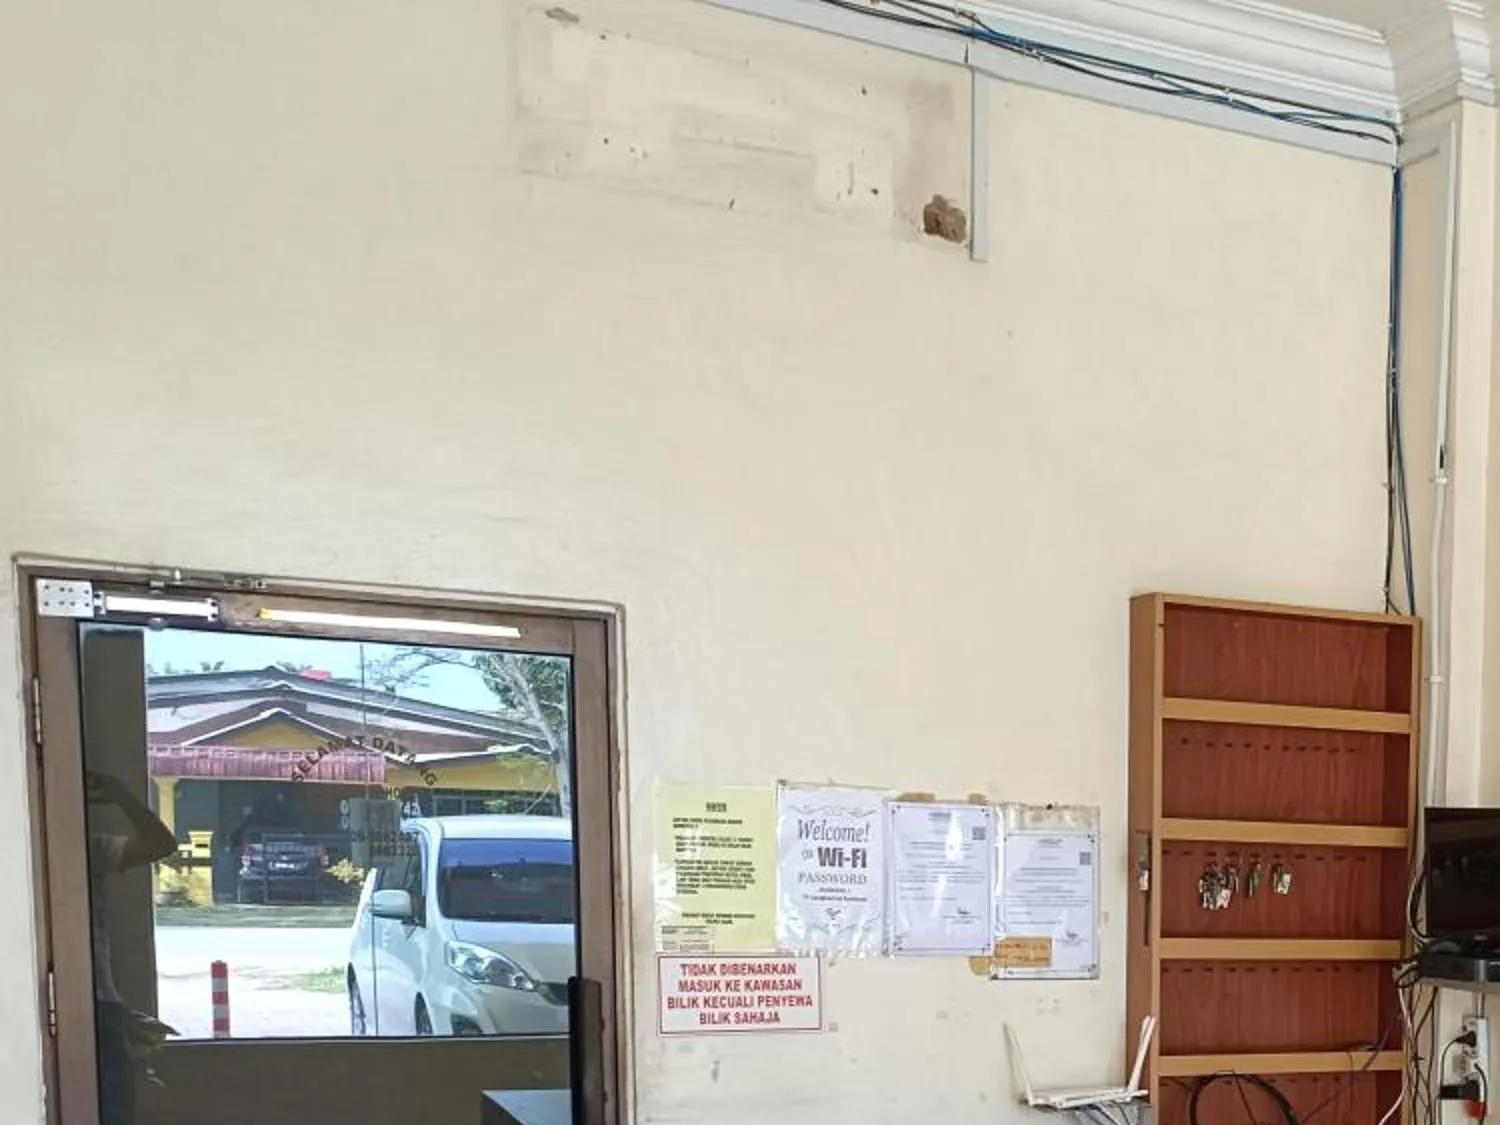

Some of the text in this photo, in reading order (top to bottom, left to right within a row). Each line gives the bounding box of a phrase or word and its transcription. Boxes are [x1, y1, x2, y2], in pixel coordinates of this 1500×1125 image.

[798, 819, 870, 843] Welcome!
[798, 871, 868, 884] PASSWORD
[680, 963, 797, 976] TIDAK DIBENARKAN
[678, 979, 802, 993] MASUK KE KAWASAN
[667, 995, 813, 1009] BILIK KECUALI PENYEWA
[699, 1011, 781, 1025] BILIK SAHAJA
